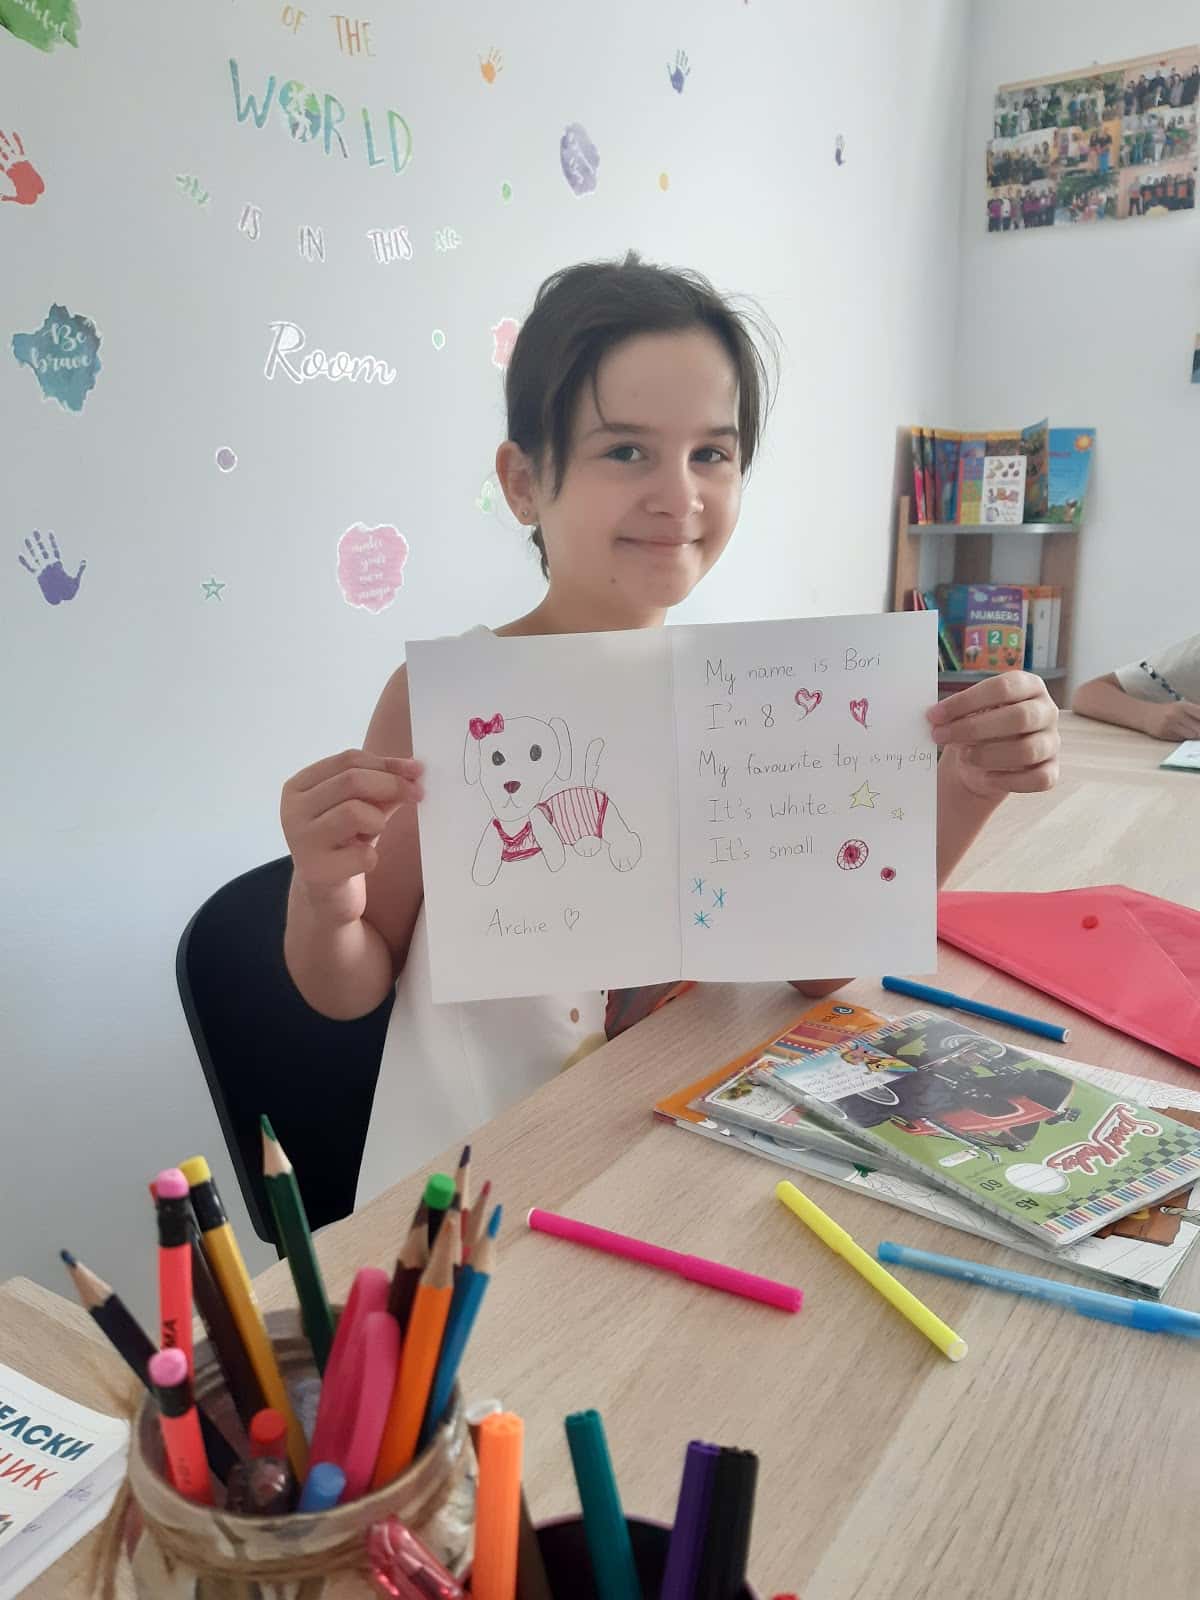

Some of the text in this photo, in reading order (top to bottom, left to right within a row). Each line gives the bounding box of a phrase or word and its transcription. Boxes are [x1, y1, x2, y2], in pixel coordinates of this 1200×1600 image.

[281, 4, 377, 57] OF THE
[239, 202, 414, 264] IS IN THIS
[42, 322, 87, 352] Be
[31, 347, 92, 373] brave
[263, 320, 397, 385] Room
[970, 609, 1019, 622] NUMBERS
[991, 630, 1001, 644] 2
[1010, 633, 1018, 647] 3
[704, 647, 881, 696] My name is Bori
[704, 702, 775, 730] I'm 8
[699, 749, 730, 788] My
[746, 749, 824, 776] favourite
[832, 743, 859, 772] toy
[870, 751, 881, 763] is
[885, 752, 903, 770] my
[707, 797, 752, 823] It's
[708, 836, 751, 864] It's
[487, 907, 547, 937] Archie
[979, 1179, 1002, 1191] 60
[1015, 1197, 1039, 1210] A5
